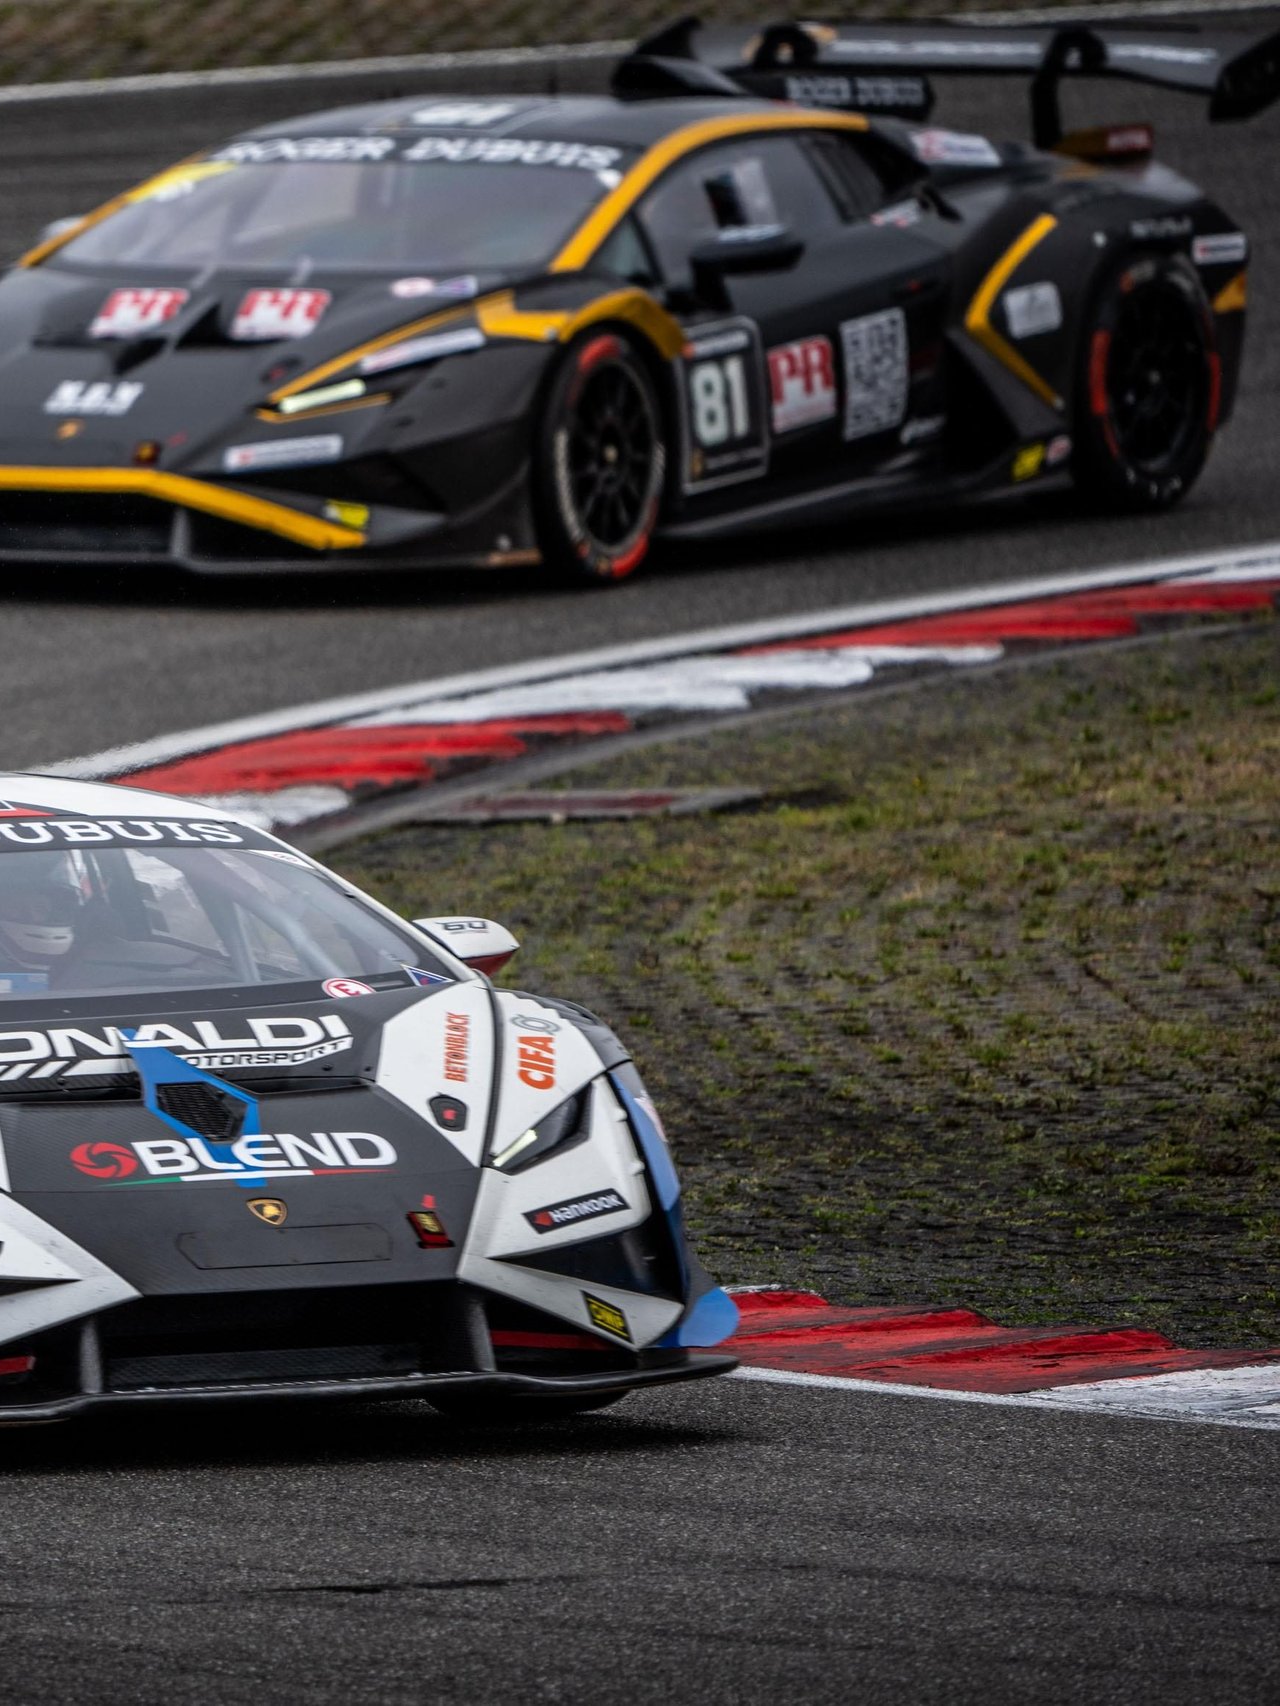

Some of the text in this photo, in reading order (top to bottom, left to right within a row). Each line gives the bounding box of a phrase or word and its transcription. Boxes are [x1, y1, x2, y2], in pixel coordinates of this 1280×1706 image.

[690, 354, 749, 447] 81
[767, 336, 834, 406] PR
[185, 1040, 345, 1067] OTORSPORT
[443, 1011, 470, 1082] BETONBLOCK
[518, 1036, 557, 1090] CIFA
[130, 1131, 399, 1177] BLEND
